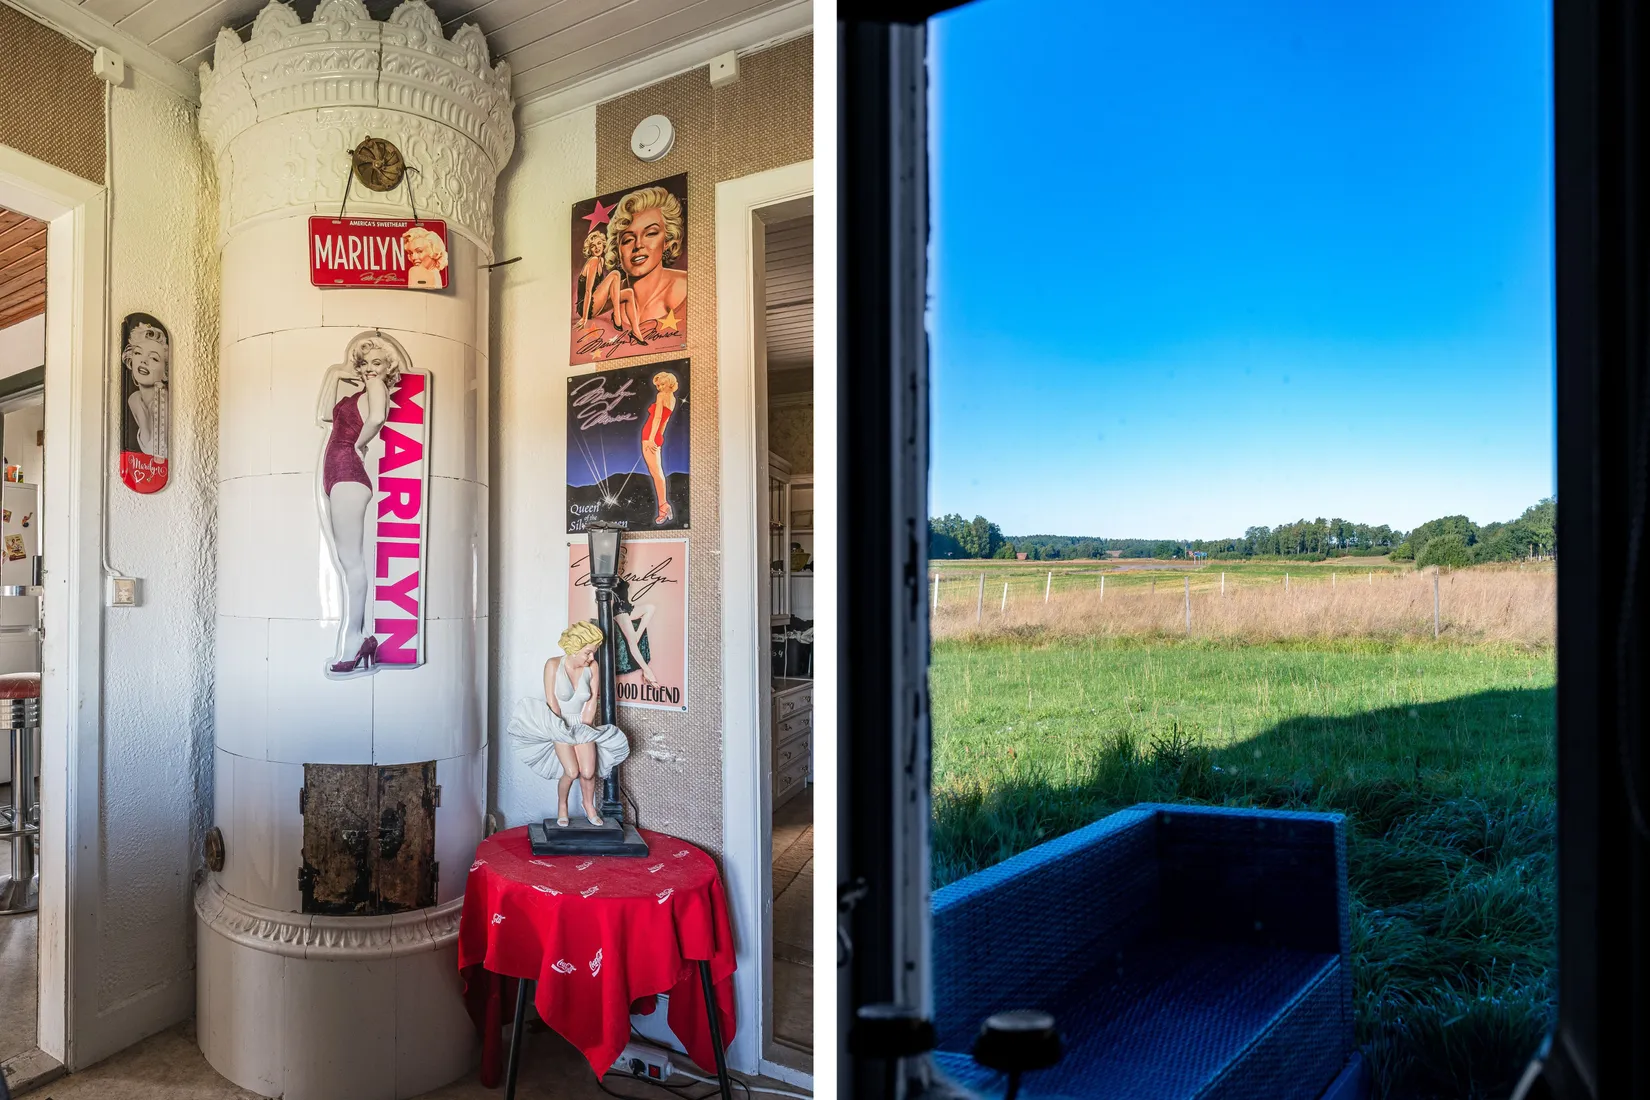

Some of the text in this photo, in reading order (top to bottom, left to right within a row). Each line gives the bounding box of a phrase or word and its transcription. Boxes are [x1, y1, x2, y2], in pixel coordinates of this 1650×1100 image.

[350, 220, 376, 228] AMERICA'S
[314, 234, 406, 271] MARILYN
[570, 500, 602, 516] Queen
[374, 372, 425, 665] MARILYN
[640, 684, 680, 704] LEGEND
